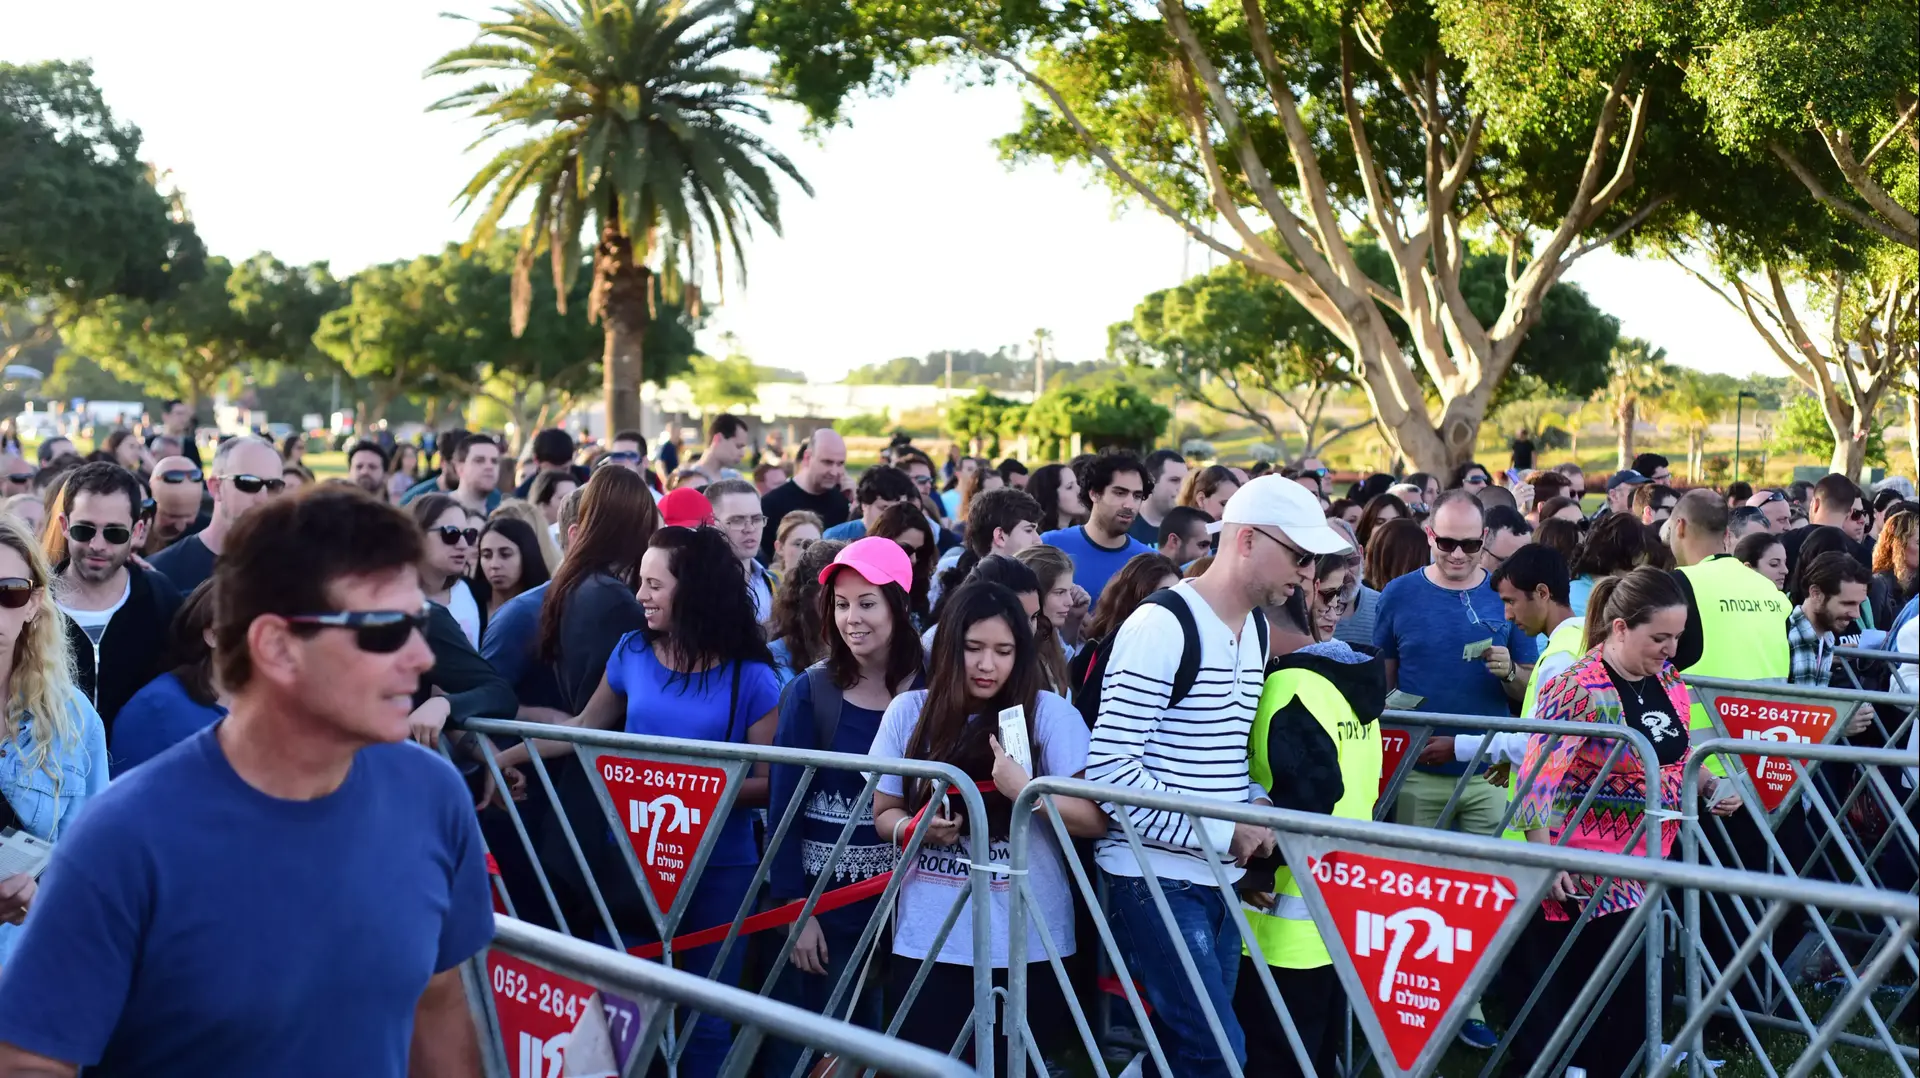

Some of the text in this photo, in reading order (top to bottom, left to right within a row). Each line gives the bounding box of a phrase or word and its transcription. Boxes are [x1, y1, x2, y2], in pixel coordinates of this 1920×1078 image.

[1719, 599, 1762, 612] אבטחה
[1720, 703, 1831, 726] 052-2647777
[1766, 760, 1793, 771] במות
[604, 764, 720, 794] 052-2647777
[1766, 771, 1792, 782] מעולם
[1767, 782, 1783, 791] אחר
[656, 842, 684, 855] במות
[656, 856, 684, 869] מעולם
[658, 871, 676, 882] אחר
[1395, 971, 1441, 991] במות
[1395, 990, 1441, 1012] מעולם
[1397, 1010, 1426, 1028] אחר
